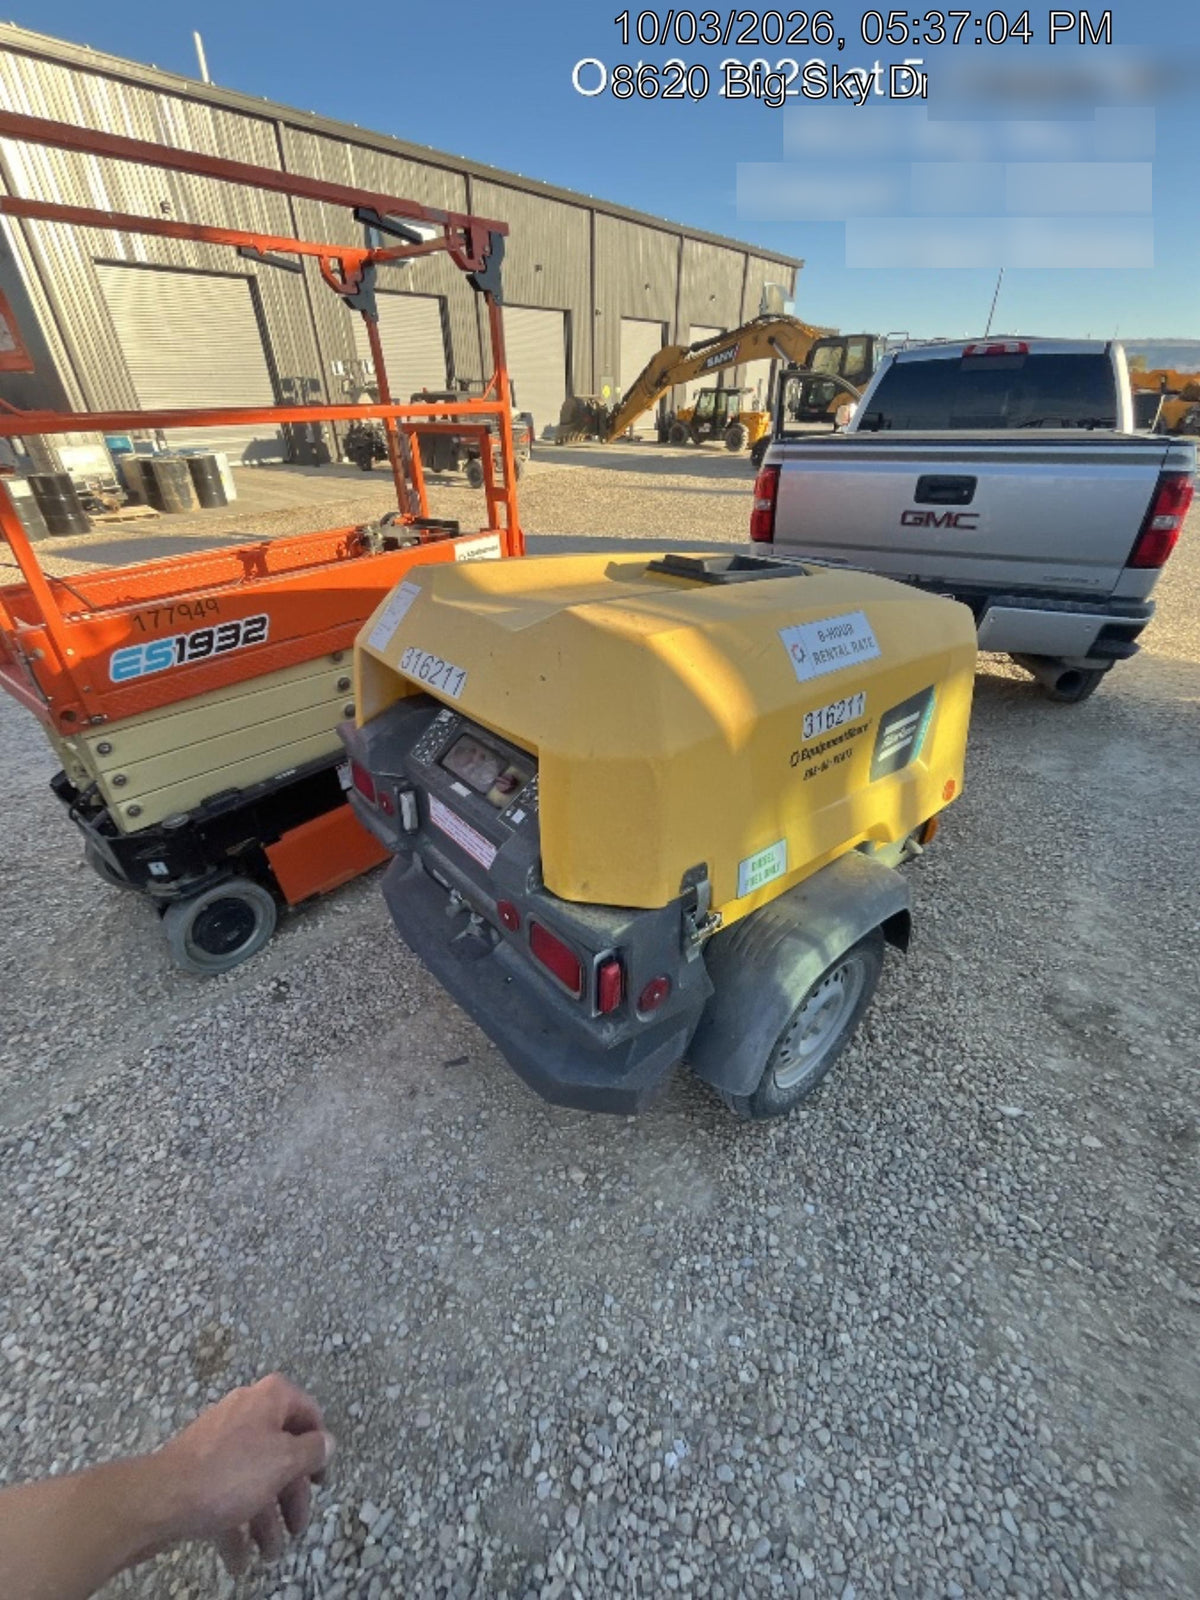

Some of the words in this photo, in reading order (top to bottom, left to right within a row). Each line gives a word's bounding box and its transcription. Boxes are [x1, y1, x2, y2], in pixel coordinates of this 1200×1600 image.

[901, 510, 980, 530] GMC
[134, 598, 220, 632] 177949
[112, 615, 268, 681] ES1932
[812, 643, 852, 665] RENTAL
[850, 637, 875, 653] RATE
[401, 647, 466, 695] 316211
[803, 693, 864, 738] 316211
